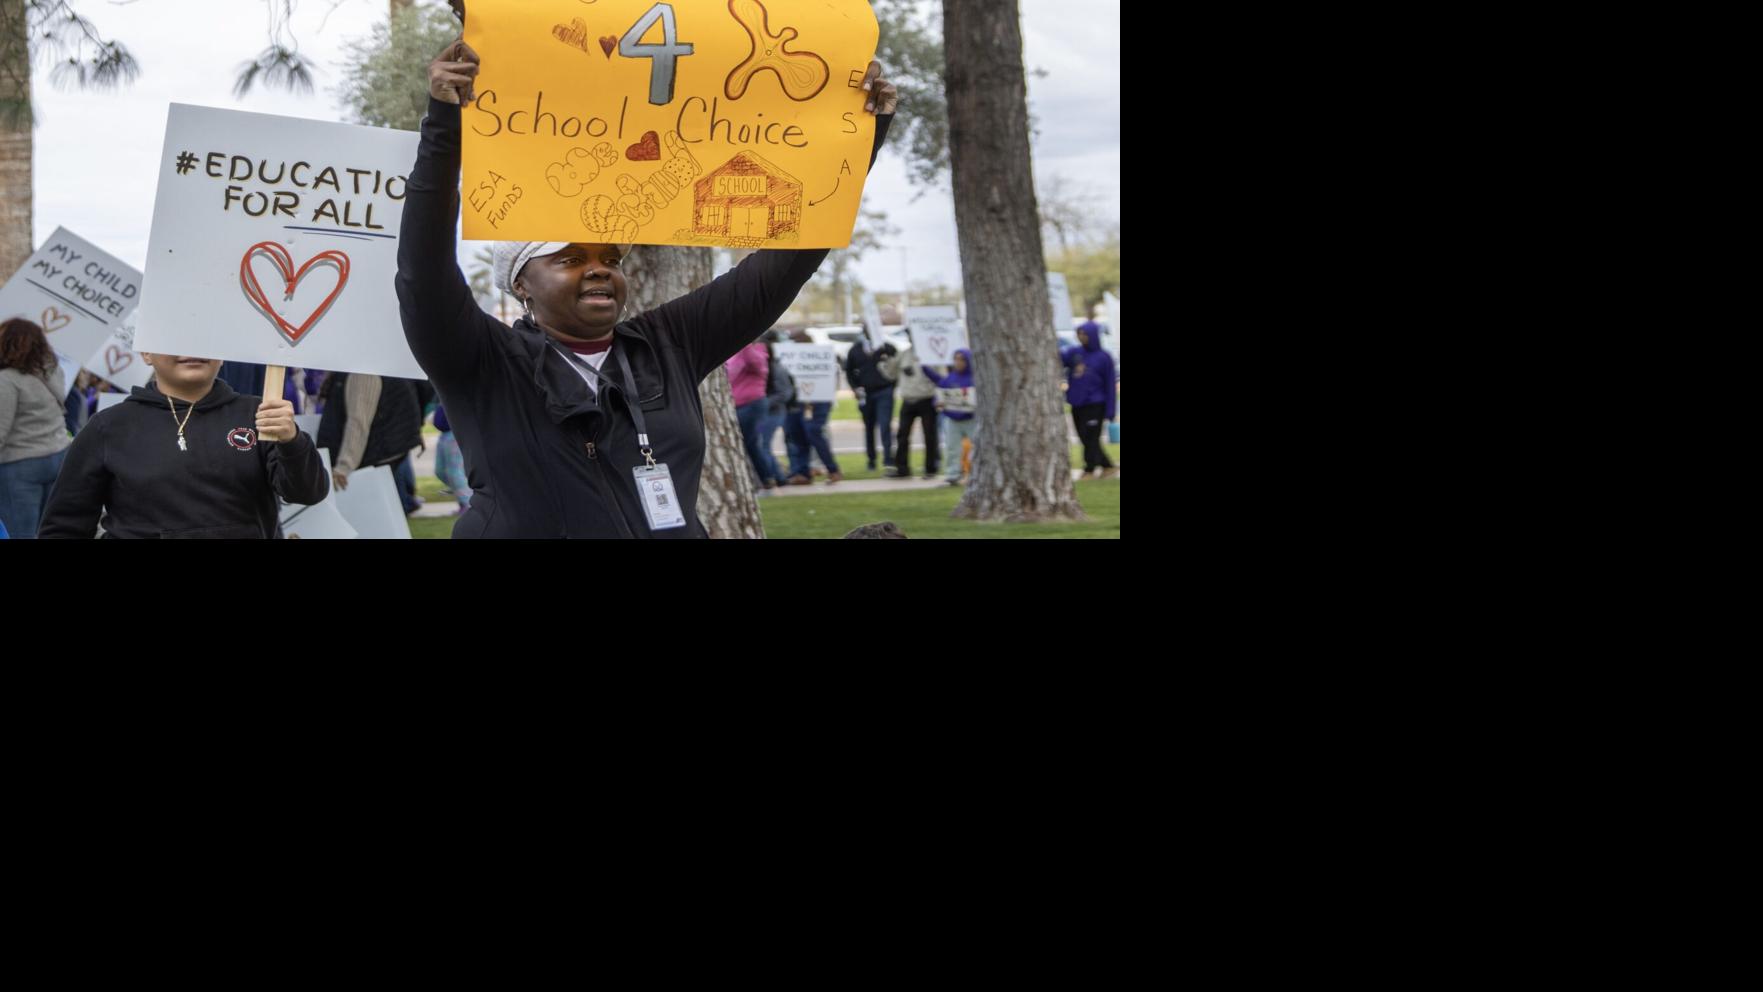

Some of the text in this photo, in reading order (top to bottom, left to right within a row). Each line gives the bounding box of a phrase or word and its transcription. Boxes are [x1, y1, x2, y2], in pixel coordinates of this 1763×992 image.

[618, 2, 694, 106] 4
[472, 90, 809, 148] School Choice
[176, 150, 407, 201] #EDUCATIO
[469, 170, 507, 213] ESA
[718, 176, 764, 196] SCHOOL
[224, 185, 384, 230] FOR ALL
[32, 260, 125, 318] MY CHOICE!
[49, 243, 137, 299] MY CHILD
